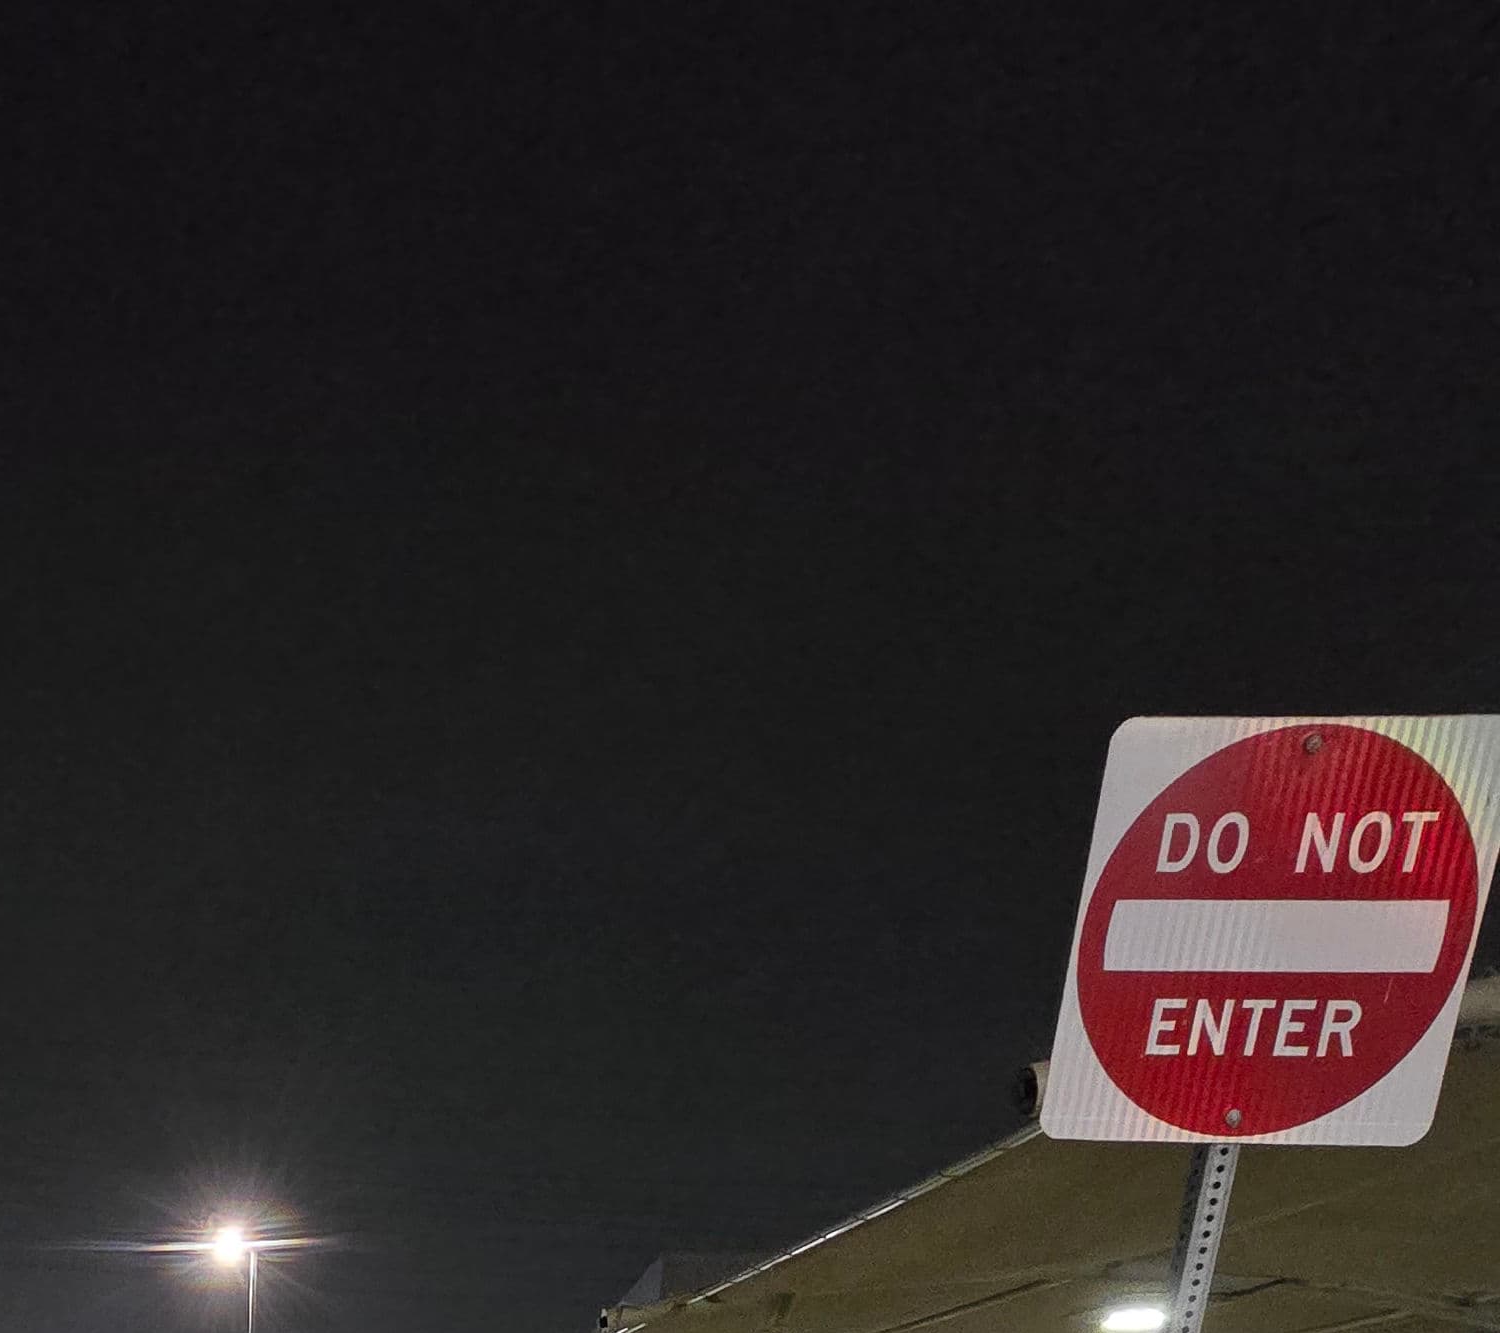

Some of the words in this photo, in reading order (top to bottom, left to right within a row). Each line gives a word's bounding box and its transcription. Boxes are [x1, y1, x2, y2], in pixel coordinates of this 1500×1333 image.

[1156, 813, 1250, 874] DO
[1295, 811, 1439, 874] NOT
[1145, 999, 1362, 1057] ENTER
